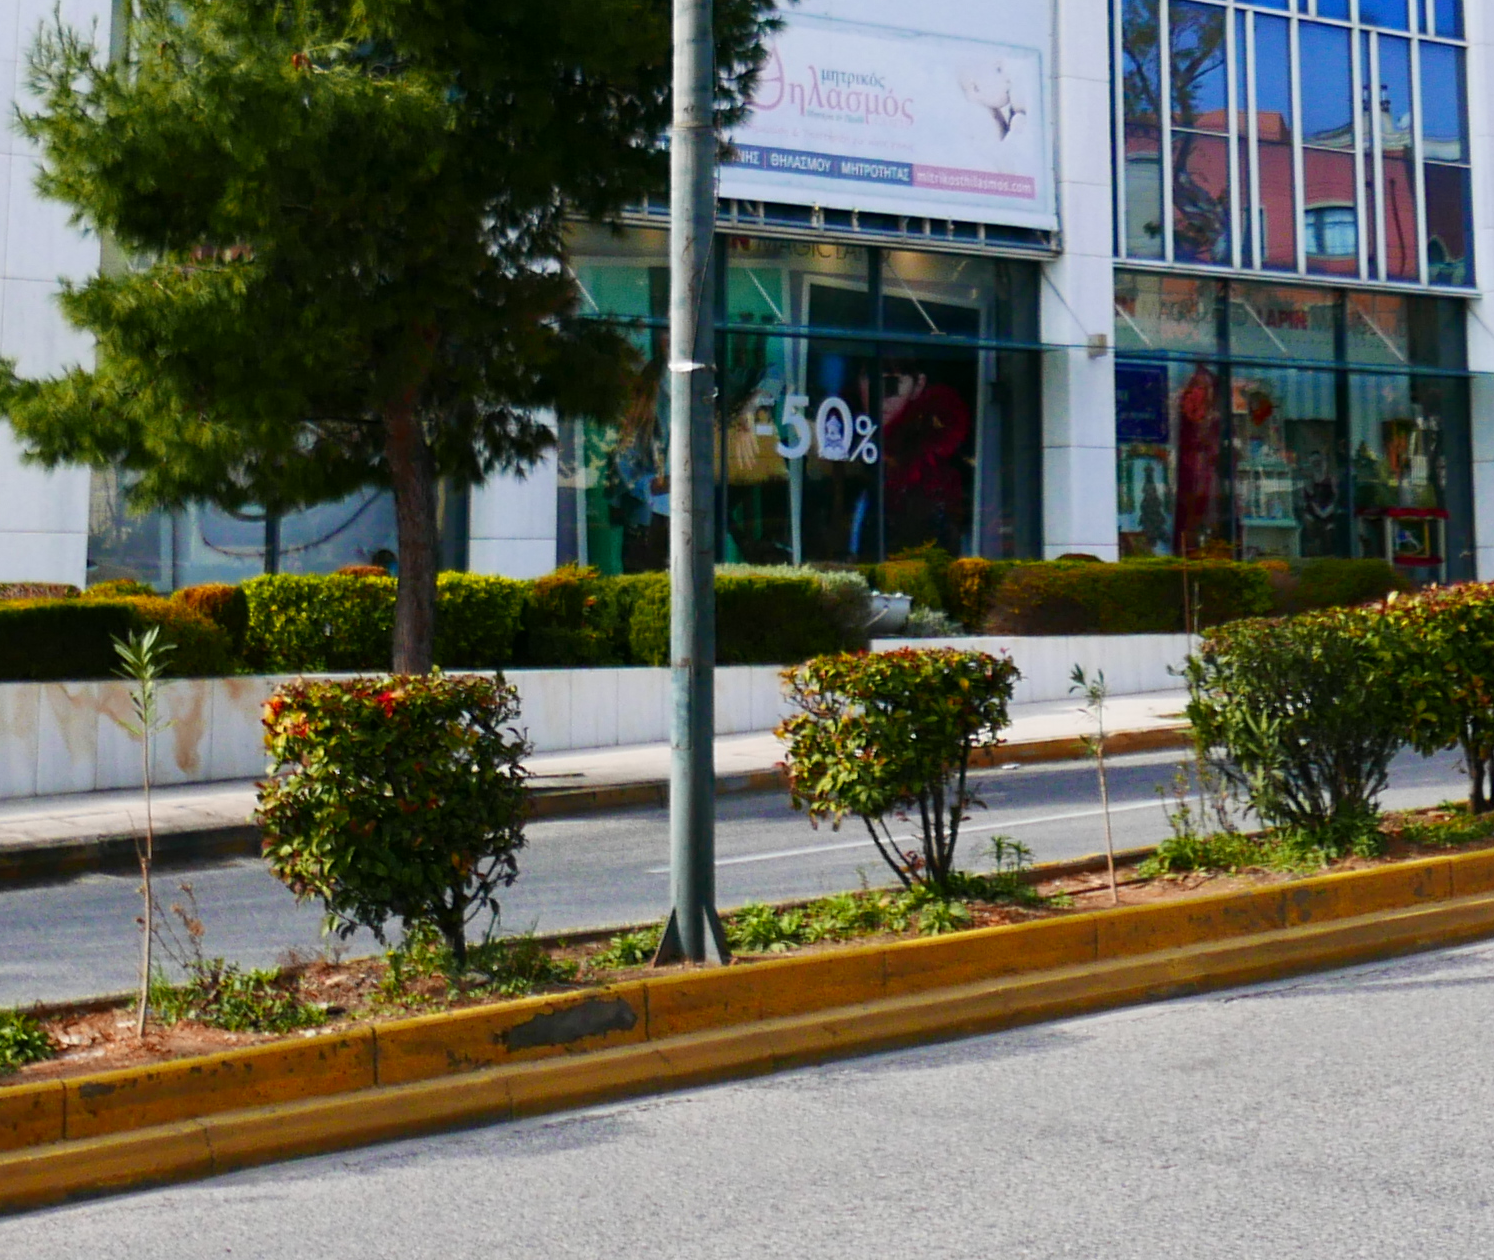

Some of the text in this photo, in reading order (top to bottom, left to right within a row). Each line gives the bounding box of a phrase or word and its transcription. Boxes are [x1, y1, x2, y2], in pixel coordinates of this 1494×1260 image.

[820, 66, 886, 90] μητρικός
[770, 153, 832, 173] ΘΗΛΑΣΜΟΥ
[840, 161, 911, 182] ΜΗΤΡΟΤΗΤΑΣ
[754, 395, 879, 465] -50%
